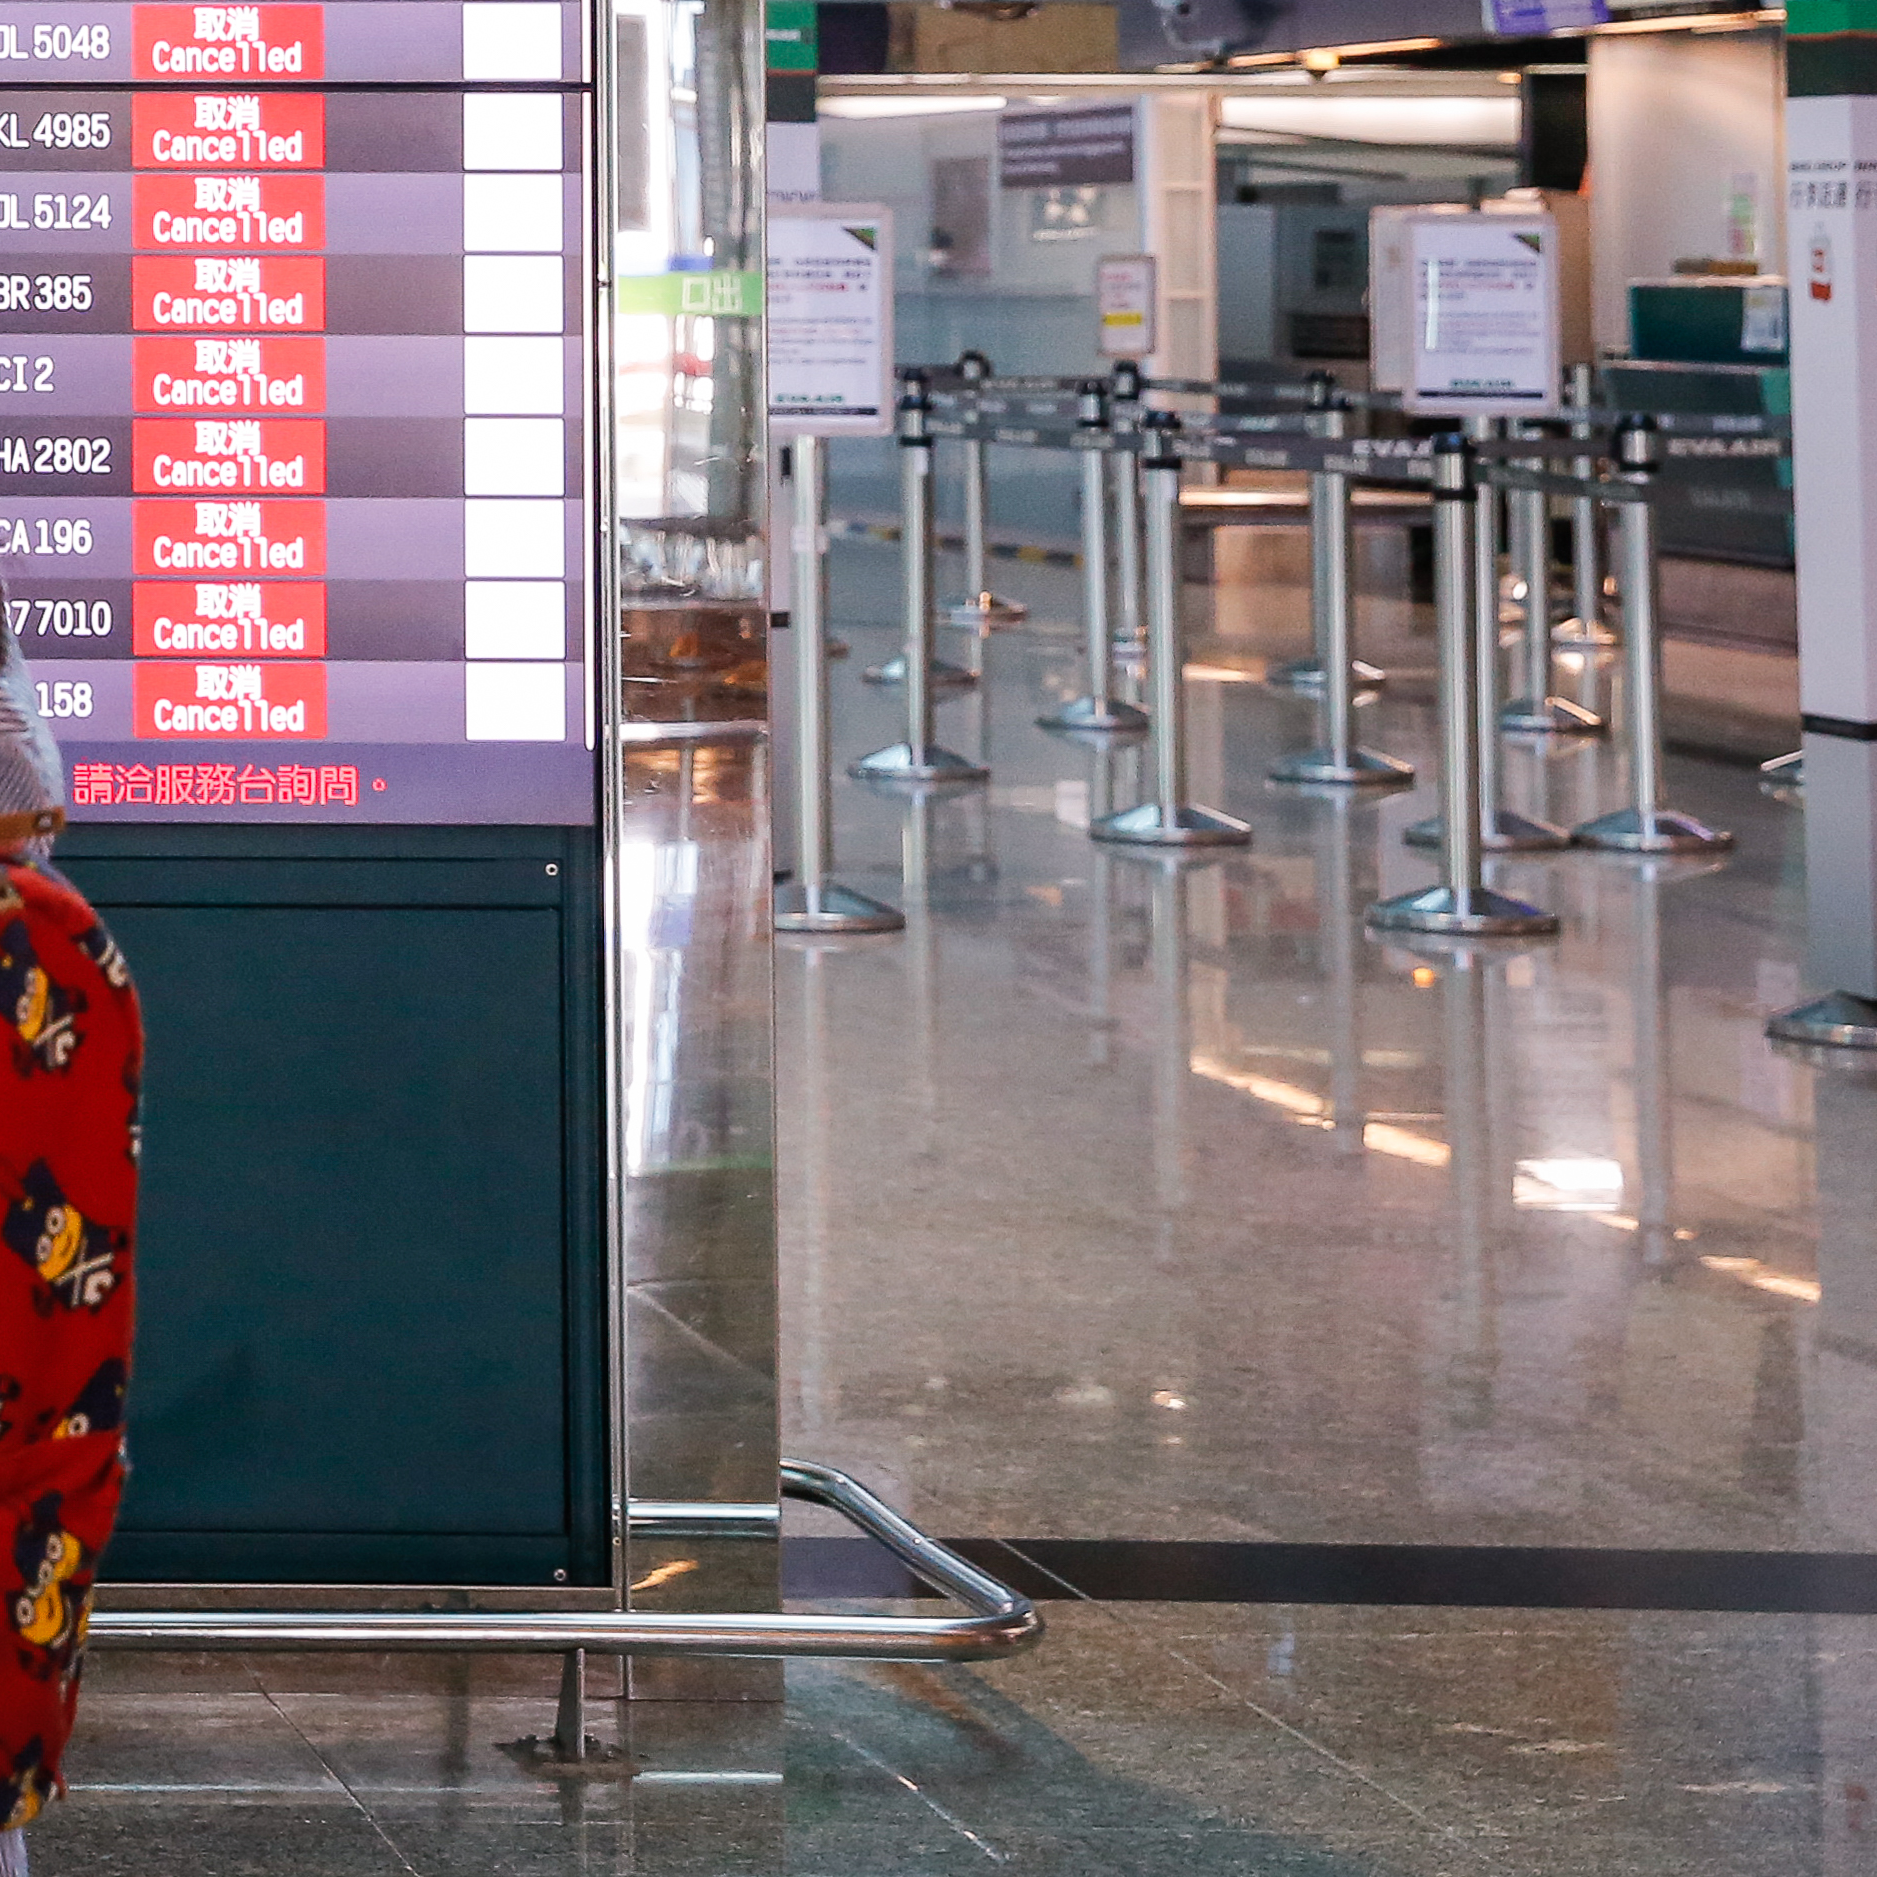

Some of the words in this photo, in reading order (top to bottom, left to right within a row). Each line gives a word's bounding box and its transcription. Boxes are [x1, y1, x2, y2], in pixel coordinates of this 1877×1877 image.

[194, 257, 260, 291] 取消
[153, 287, 303, 324] Cancelled
[195, 664, 261, 699] 取消
[154, 695, 304, 732] Cancelled
